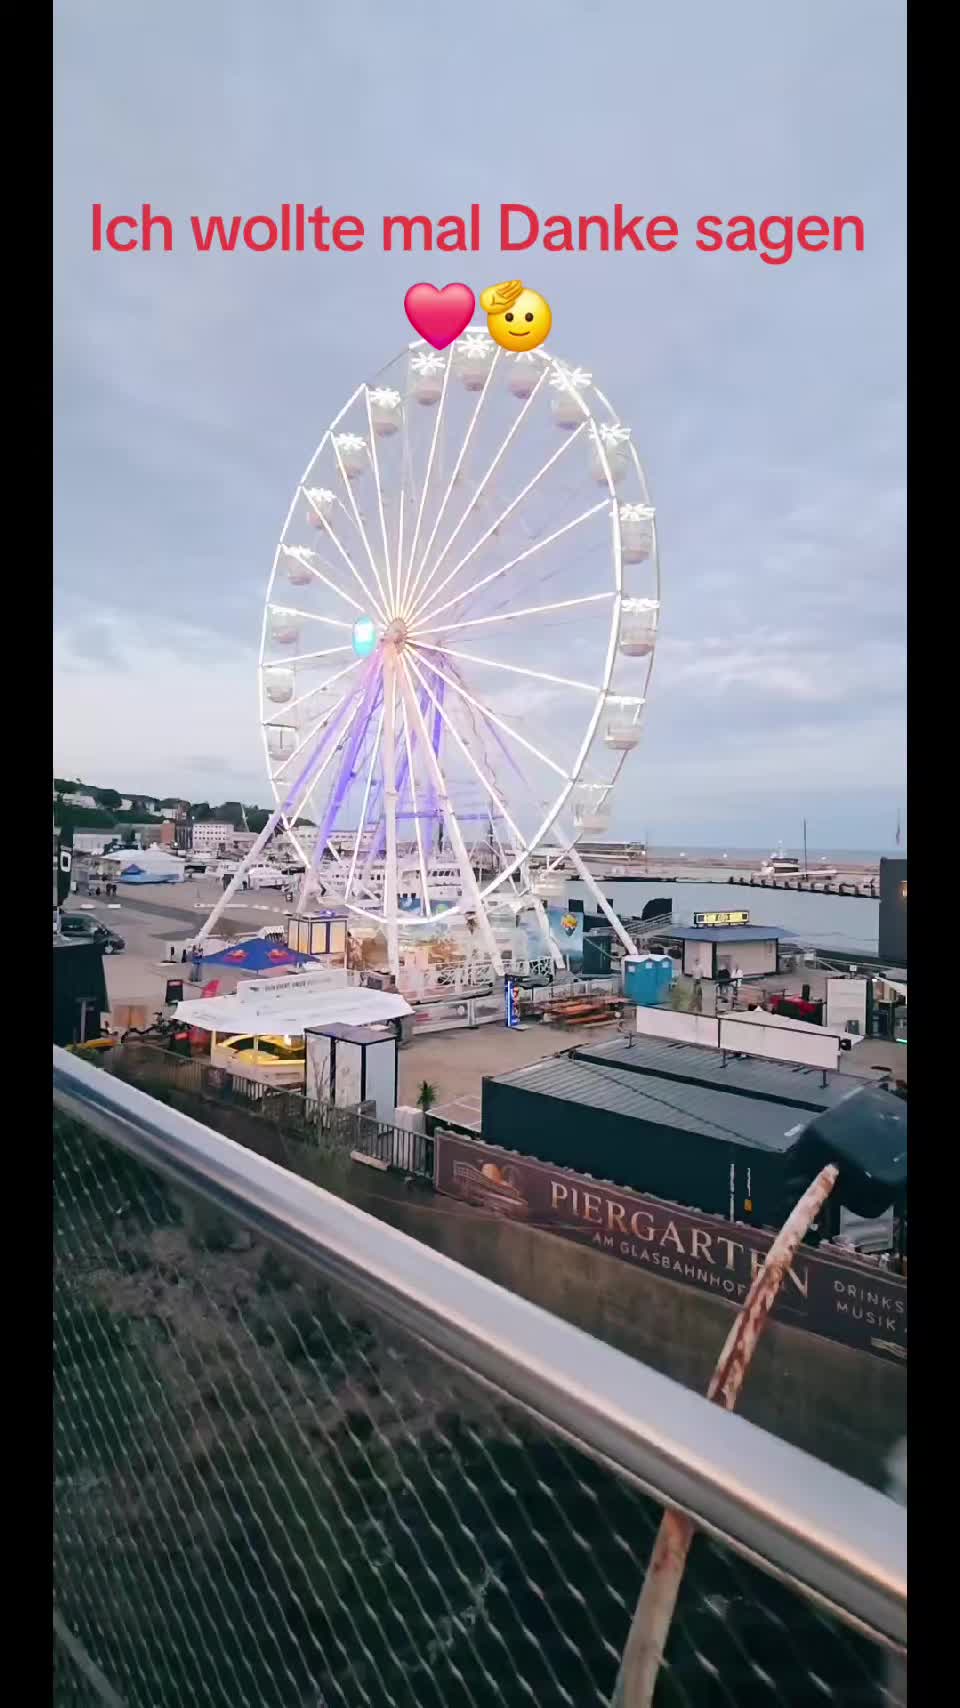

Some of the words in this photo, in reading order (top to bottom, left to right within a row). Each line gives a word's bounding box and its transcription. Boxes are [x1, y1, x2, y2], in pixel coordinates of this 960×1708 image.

[592, 1232, 615, 1249] AM
[619, 1241, 748, 1296] GLASBAHNHOF
[833, 1279, 906, 1314] DRINKS
[836, 1300, 897, 1332] MUSIK
